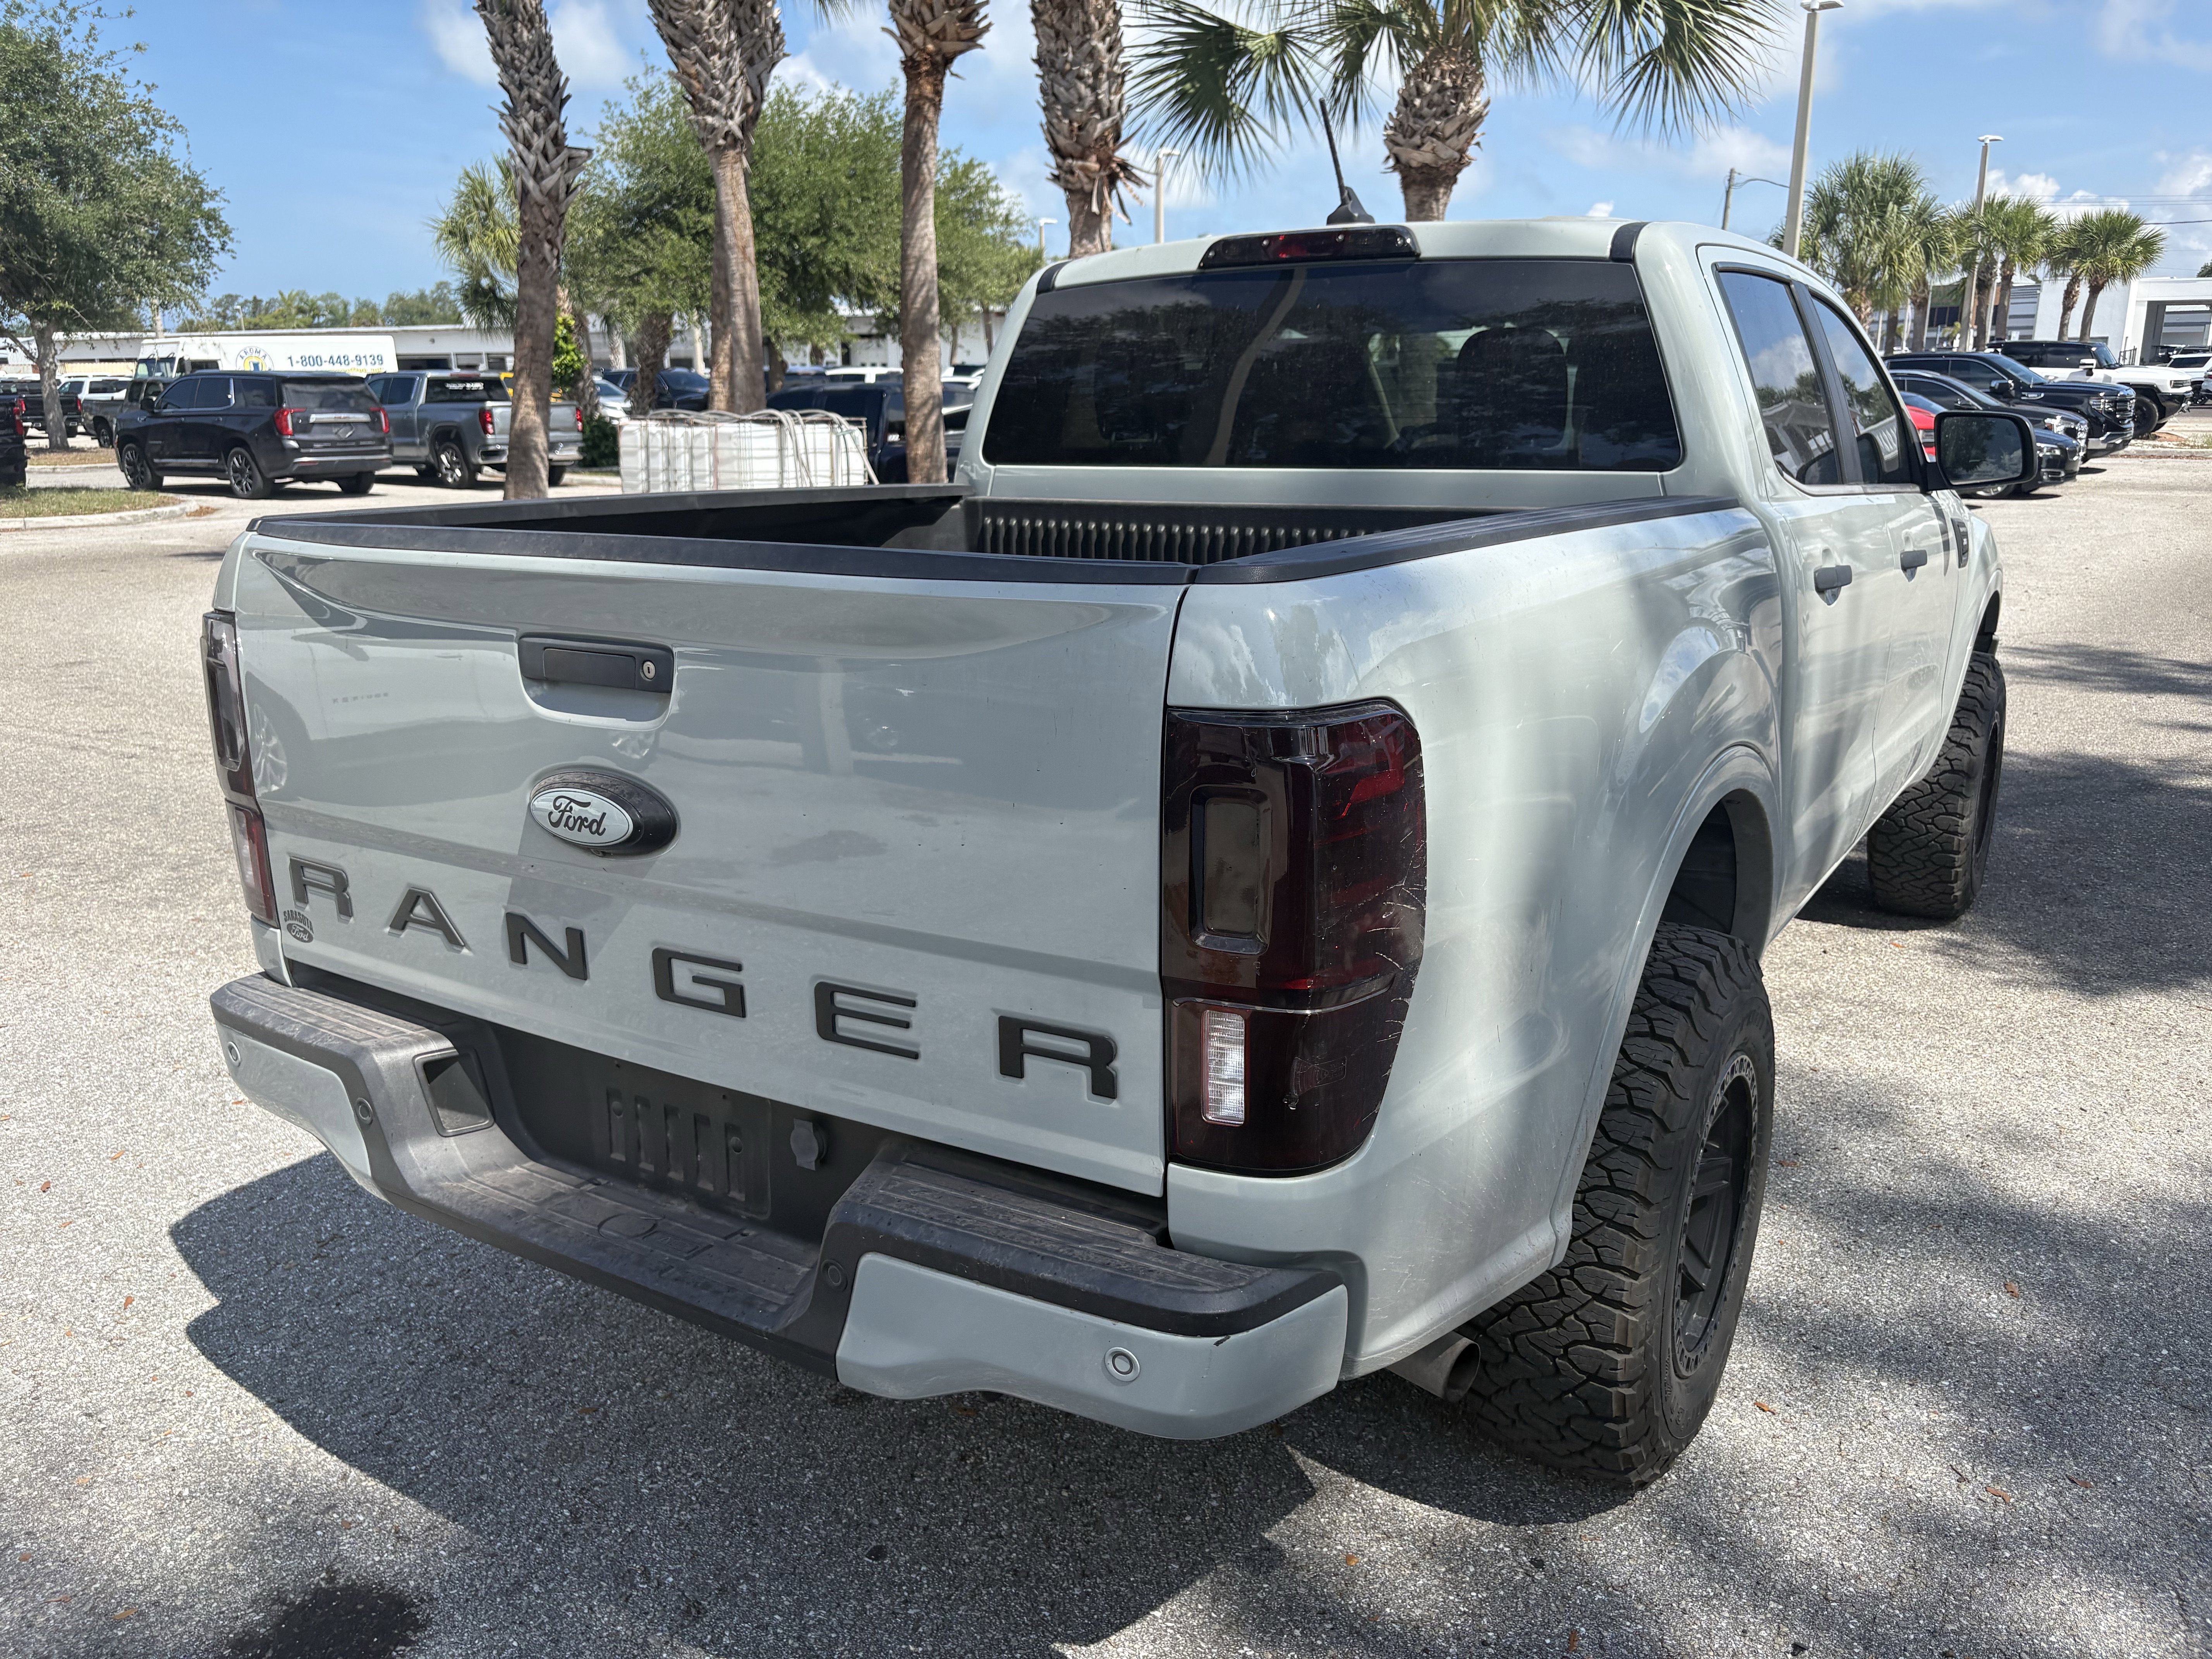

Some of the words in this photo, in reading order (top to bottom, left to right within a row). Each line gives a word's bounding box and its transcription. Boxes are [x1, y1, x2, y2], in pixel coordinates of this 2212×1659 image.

[240, 347, 267, 360] AROMA
[288, 354, 384, 367] 1-800-448-9139
[548, 795, 606, 836] Ford
[283, 910, 314, 934] SARASOTA
[291, 924, 309, 941] Ford
[289, 856, 1117, 1099] RANGER
